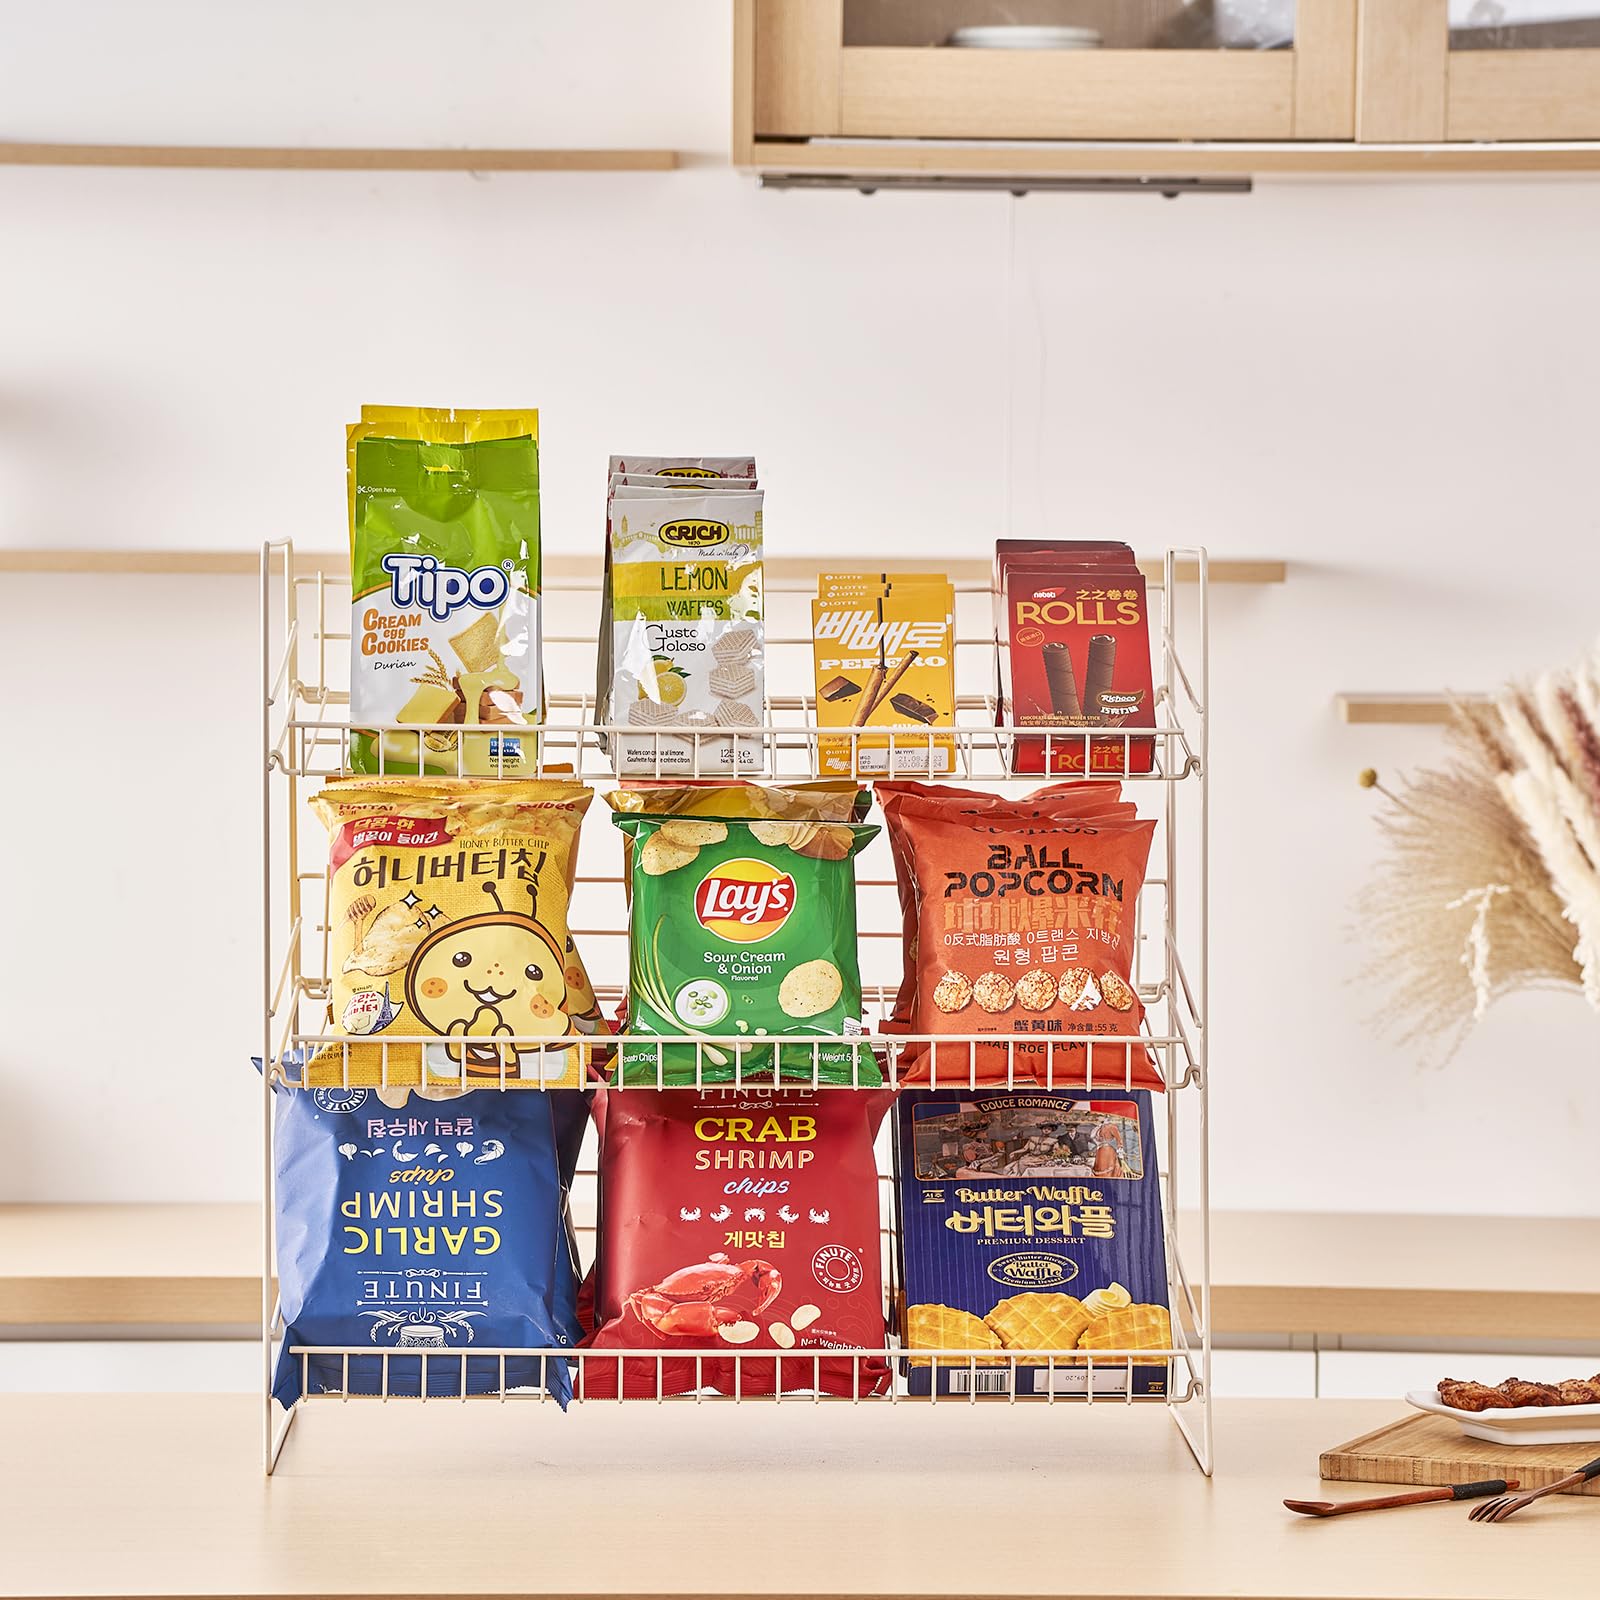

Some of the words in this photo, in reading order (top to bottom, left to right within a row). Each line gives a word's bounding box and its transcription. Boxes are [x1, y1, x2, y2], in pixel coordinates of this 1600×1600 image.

[665, 525, 722, 540] CRICH
[381, 553, 511, 623] Tipo
[660, 567, 728, 591] LEMON
[362, 608, 422, 631] CREAM
[1016, 601, 1141, 625] ROLLS
[383, 627, 406, 639] egg
[814, 610, 947, 656] 빼빼로
[361, 632, 430, 656] COOKIES
[374, 659, 417, 671] Durian
[1100, 695, 1137, 703] Richoco
[397, 831, 439, 844] 들어간
[460, 840, 490, 849] HONEY
[527, 838, 549, 849] CHIP
[987, 844, 1083, 869] BALL
[353, 848, 546, 889] 허니버터칩
[944, 869, 1124, 902] POPCORN
[701, 878, 790, 924] Lay's
[703, 951, 737, 963] Sour
[740, 951, 786, 962] Cream
[717, 963, 729, 974] &
[731, 963, 772, 974] Onion
[1014, 1019, 1063, 1032] 蟹黄味
[639, 1053, 658, 1063] Chips
[822, 1052, 845, 1062] Weight
[1018, 1043, 1045, 1054] ROE
[325, 1090, 365, 1110] FINUTE
[980, 1098, 1016, 1112] DOUCE
[1017, 1098, 1070, 1110] ROMANCE
[367, 1118, 429, 1138] 새우칩
[435, 1118, 474, 1136] 갈릭
[694, 1116, 817, 1142] CRAB
[694, 1149, 815, 1170] SHRIMP
[389, 1165, 455, 1185] chips
[723, 1176, 790, 1198] chips
[955, 1187, 1027, 1203] Butter
[1026, 1186, 1104, 1205] Waffle
[340, 1189, 504, 1219] SHRIMP
[945, 1204, 1116, 1239] 버터와플
[343, 1226, 502, 1256] GARLIC
[723, 1230, 785, 1249] 게맛칩
[815, 1248, 853, 1269] FINUTE
[1005, 1267, 1060, 1279] Waffle
[364, 1280, 481, 1298] FINUTE
[801, 1338, 818, 1347] Net
